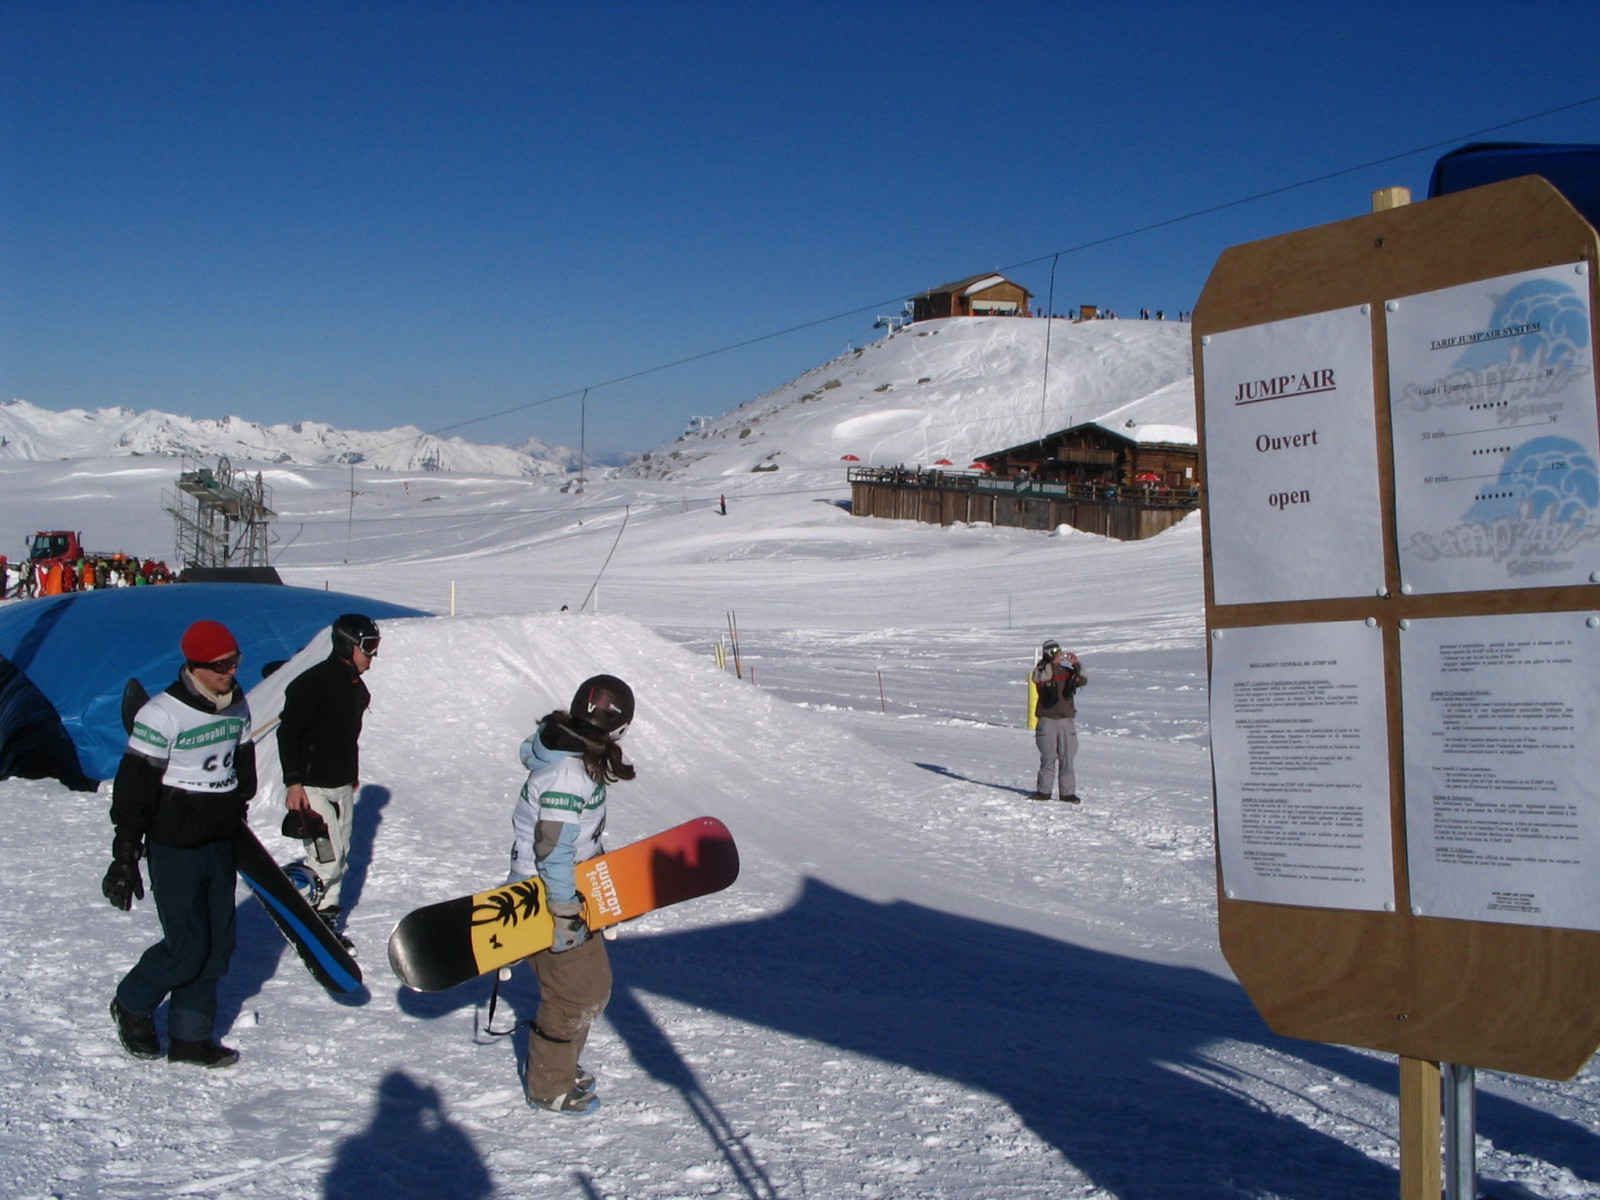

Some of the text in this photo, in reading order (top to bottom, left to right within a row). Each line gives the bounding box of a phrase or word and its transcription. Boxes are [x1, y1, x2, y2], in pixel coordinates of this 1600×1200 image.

[1431, 339, 1456, 350] TARIF
[1503, 322, 1541, 336] SYSTEM
[1234, 369, 1337, 404] JUMP'AIR
[1255, 428, 1319, 453] Ouvert
[1268, 487, 1311, 512] open
[585, 869, 611, 916] feelgood
[595, 859, 623, 917] BURTON
